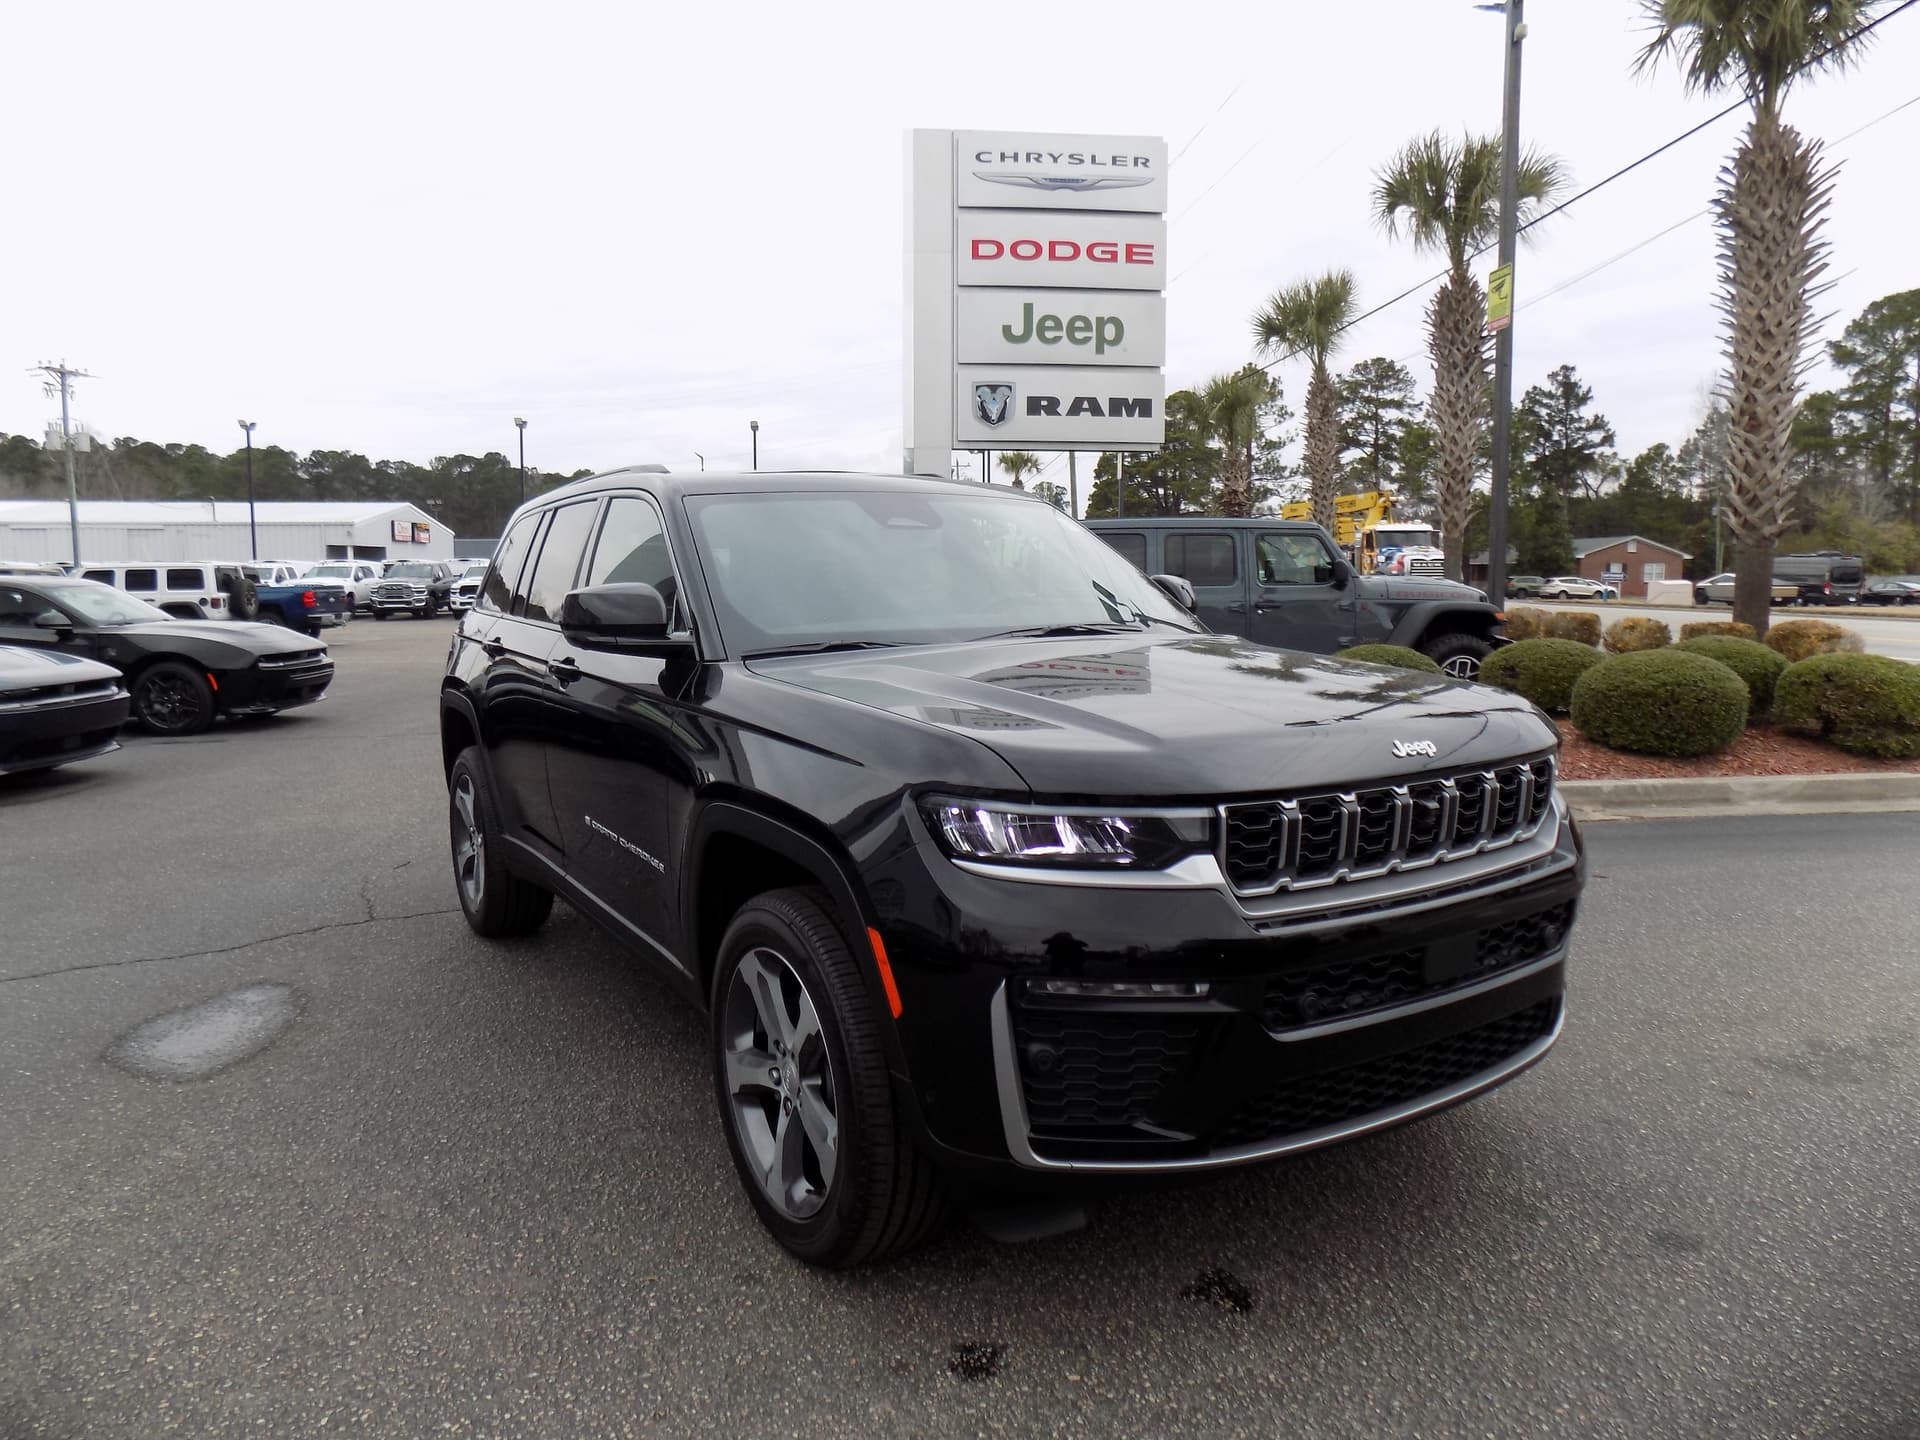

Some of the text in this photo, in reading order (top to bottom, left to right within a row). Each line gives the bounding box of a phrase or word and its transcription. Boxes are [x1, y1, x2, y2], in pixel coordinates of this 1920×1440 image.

[975, 151, 1151, 169] CHRYSLER
[971, 239, 1155, 265] DODGE
[1002, 302, 1125, 355] Jeep
[1026, 395, 1153, 418] RAM
[1392, 739, 1437, 757] Jeep
